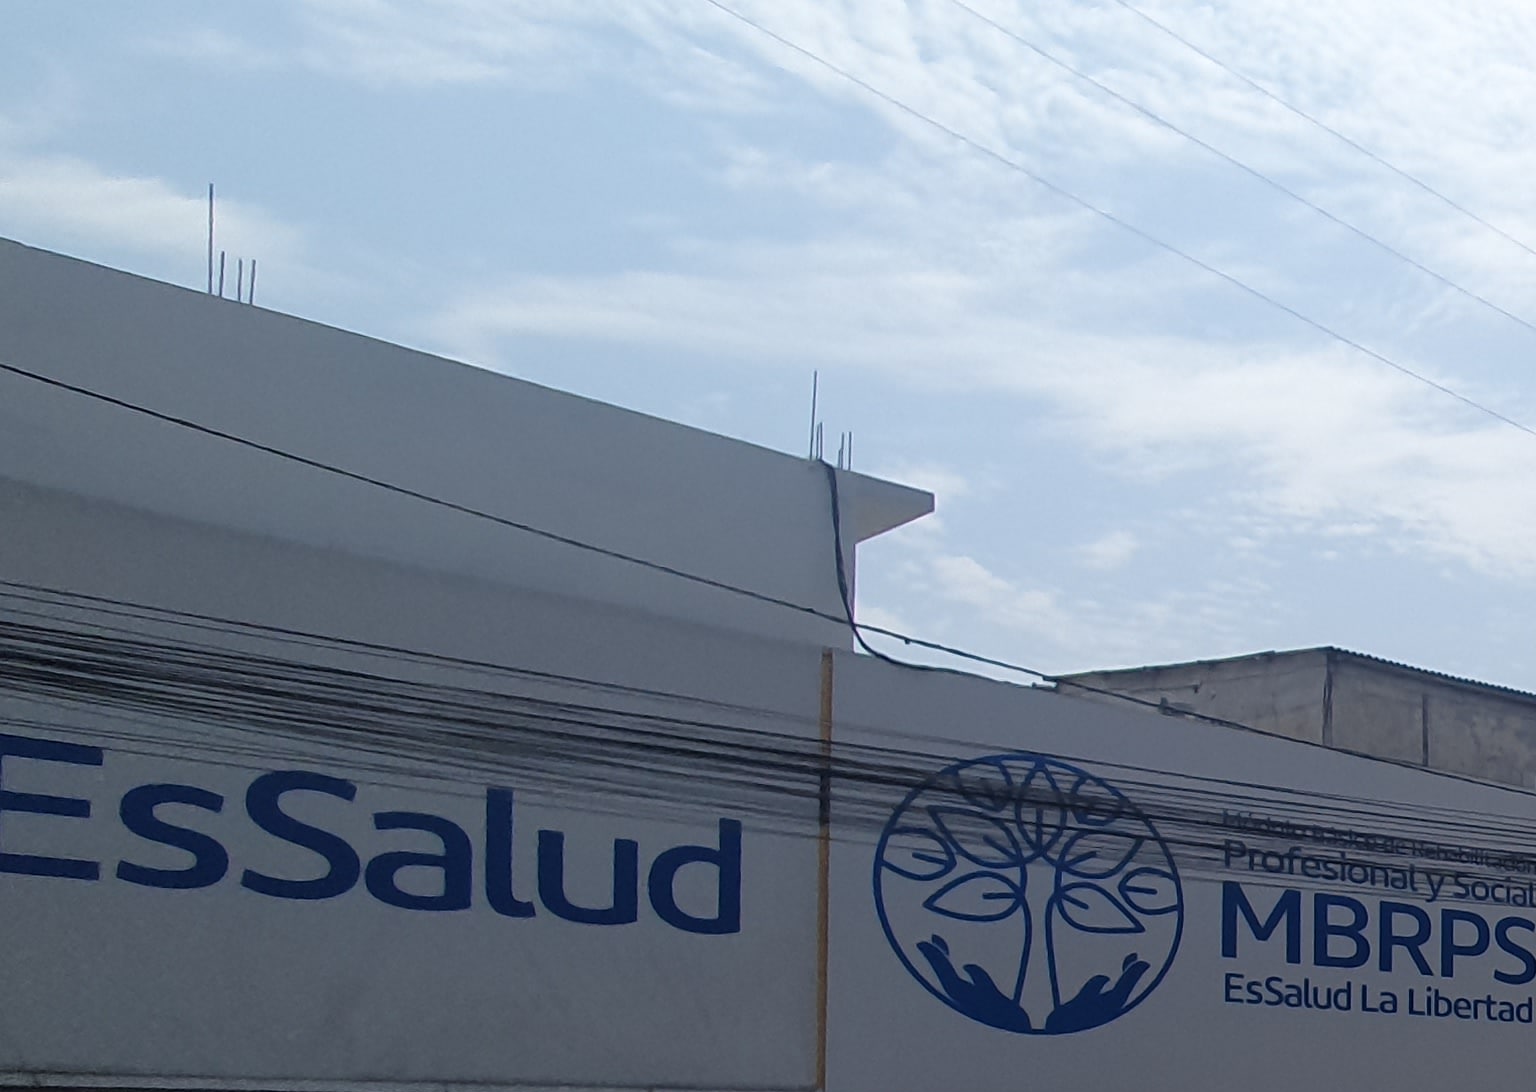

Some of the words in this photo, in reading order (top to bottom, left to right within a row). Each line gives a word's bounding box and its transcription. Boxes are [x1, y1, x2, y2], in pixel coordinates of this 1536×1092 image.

[0, 734, 742, 935] EsSalud
[1223, 838, 1418, 893] Profesional
[1425, 872, 1445, 903] y
[1453, 870, 1536, 908] Social
[1224, 972, 1352, 1012] EsSalud
[1361, 984, 1398, 1014] La
[1408, 986, 1534, 1024] Libertad
